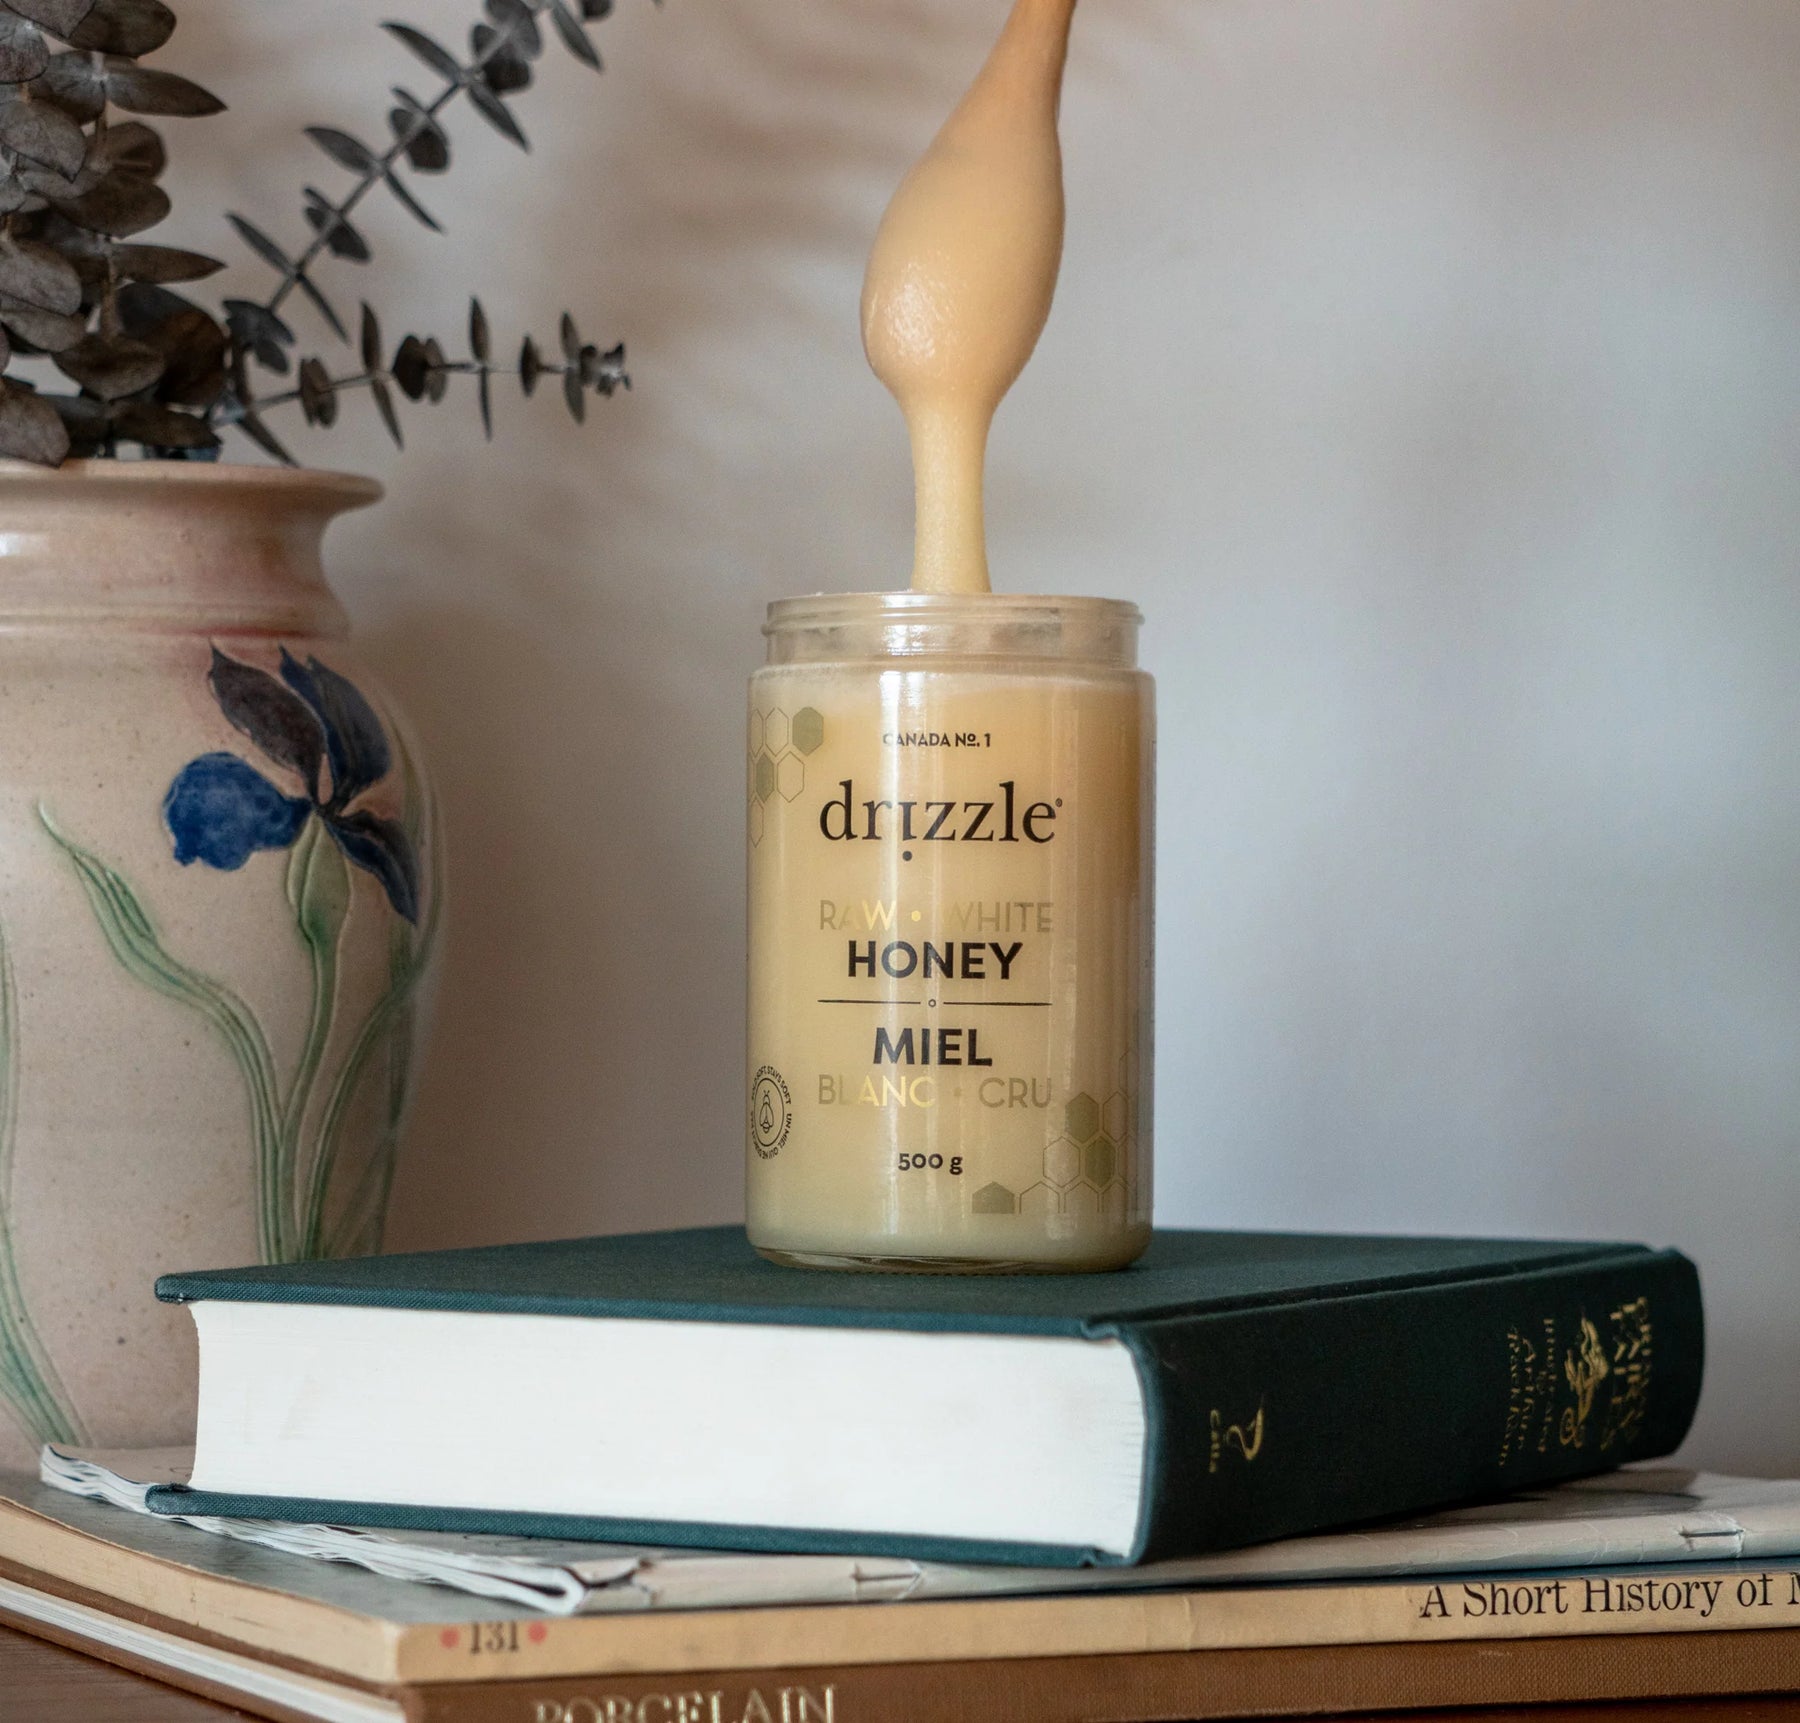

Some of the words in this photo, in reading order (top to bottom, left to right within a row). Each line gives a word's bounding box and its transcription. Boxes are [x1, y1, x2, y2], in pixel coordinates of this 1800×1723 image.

[883, 732, 951, 747] CANADA
[983, 732, 991, 748] 1
[819, 899, 897, 931] RAW
[942, 901, 1054, 933] WHITE
[848, 940, 1023, 980] HONEY
[873, 1027, 993, 1067] MIEL
[818, 1074, 937, 1109] BLANC
[978, 1077, 1052, 1109] CRU
[898, 1153, 943, 1172] 500
[949, 1154, 964, 1175] g
[1419, 1584, 1452, 1619] A
[1463, 1581, 1569, 1618] Short
[1580, 1577, 1723, 1618] History
[470, 1620, 520, 1655] 131
[534, 1684, 836, 1723] PORCELAIN
